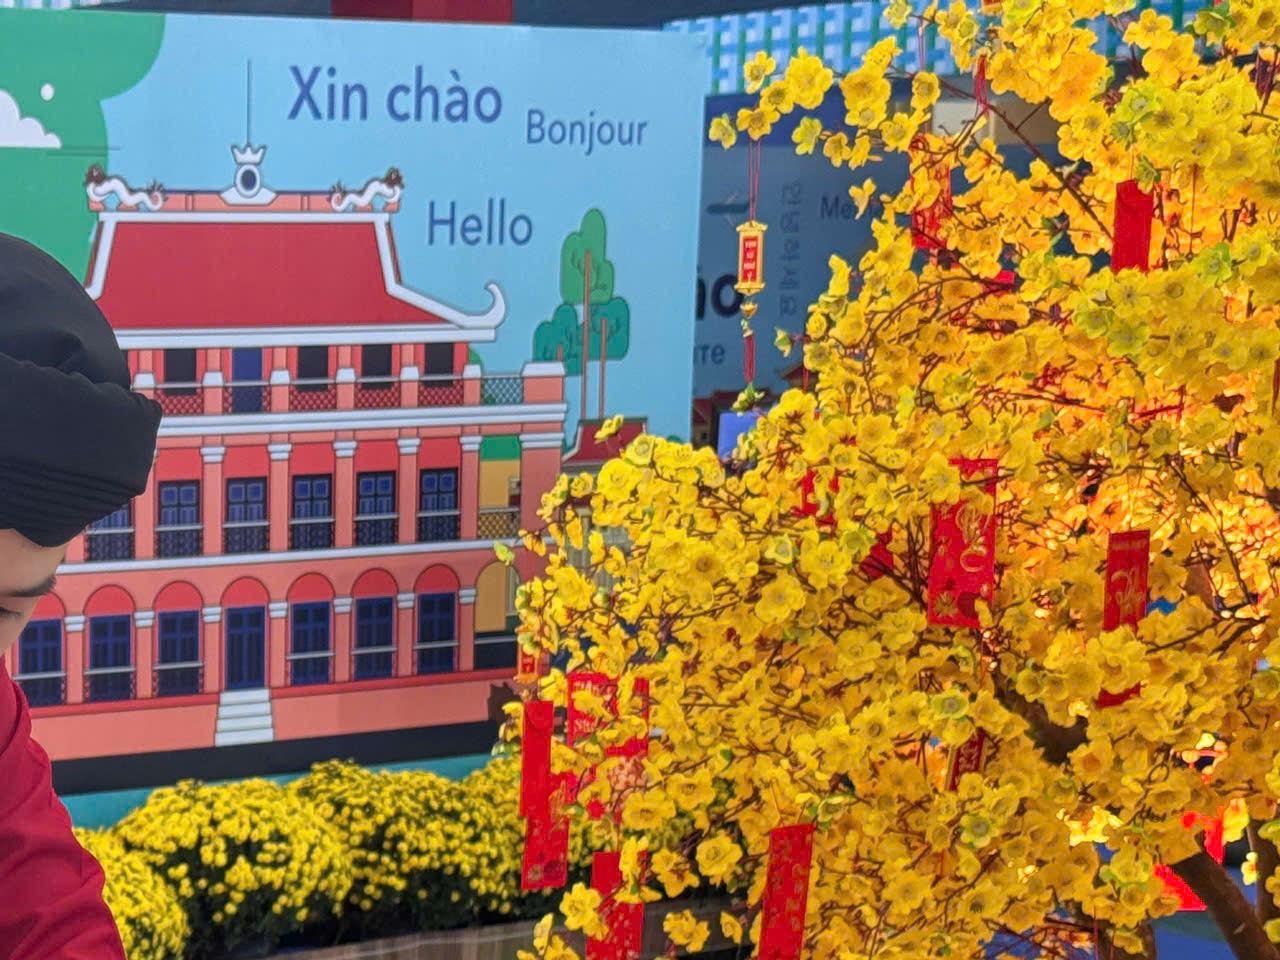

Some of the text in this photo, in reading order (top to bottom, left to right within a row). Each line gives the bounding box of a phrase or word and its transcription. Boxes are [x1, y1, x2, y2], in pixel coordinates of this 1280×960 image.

[287, 64, 503, 123] Xin chào
[526, 109, 648, 156] Bonjour
[427, 197, 533, 246] Hello
